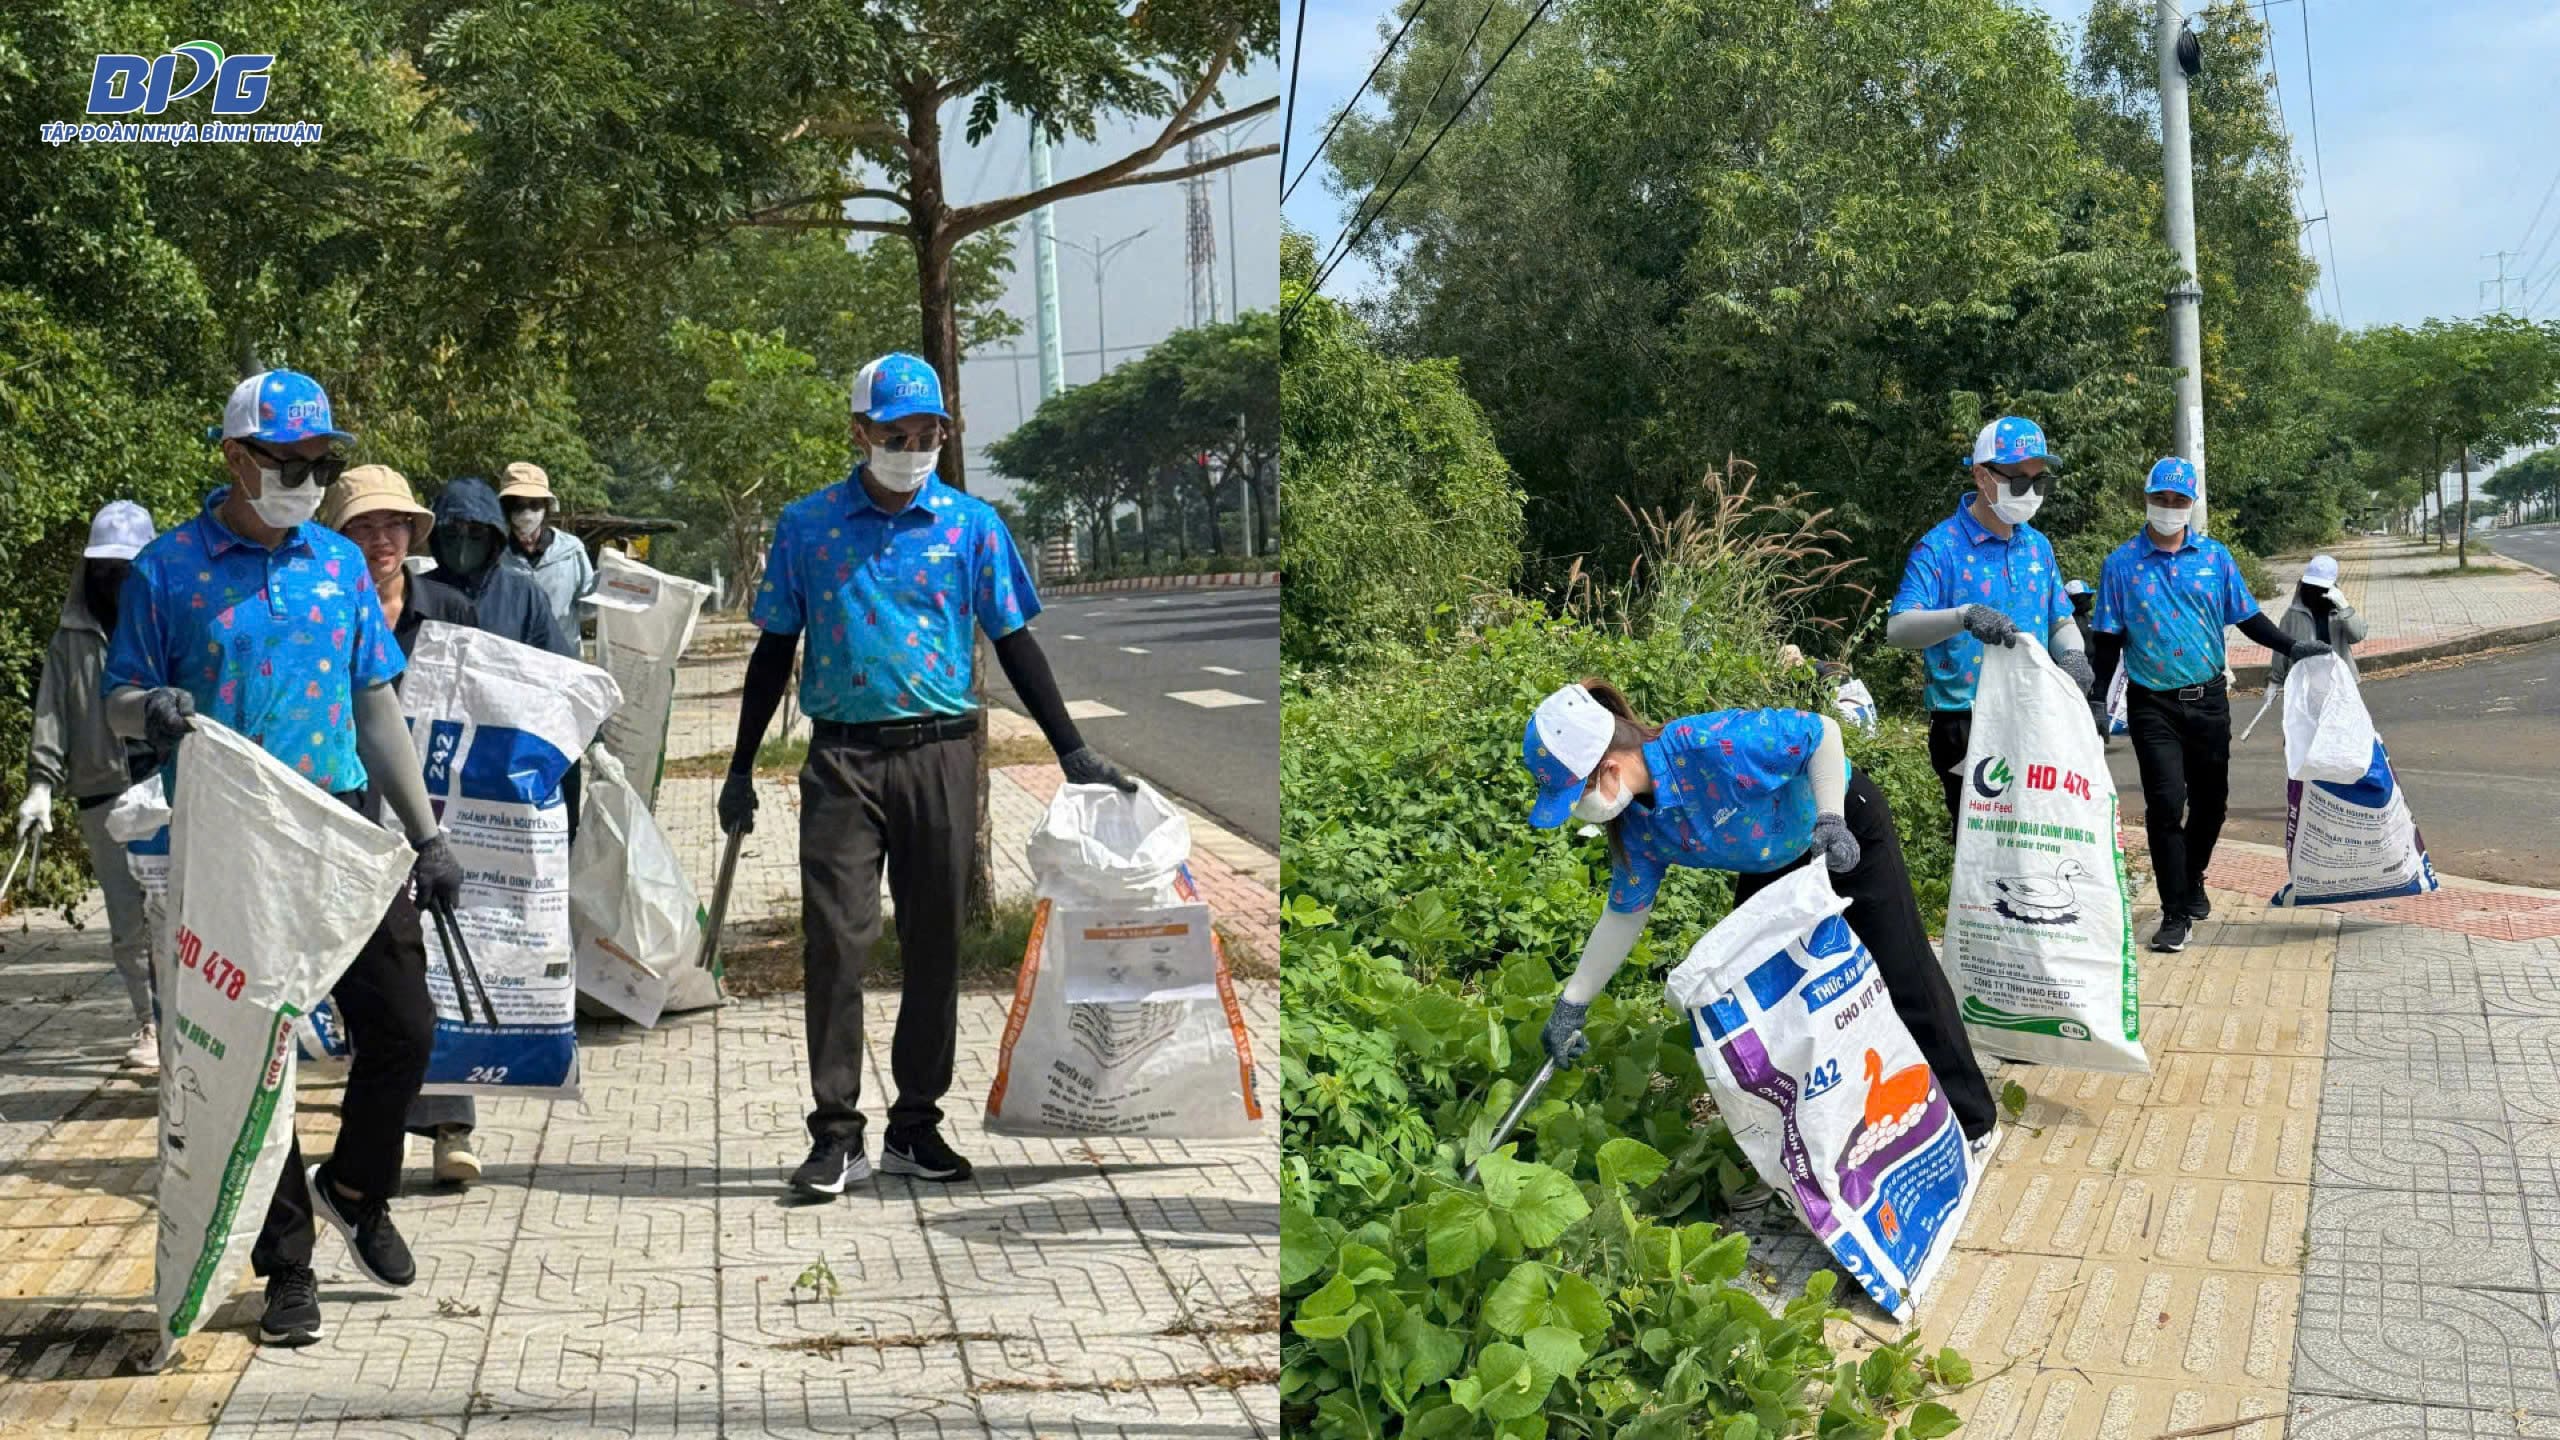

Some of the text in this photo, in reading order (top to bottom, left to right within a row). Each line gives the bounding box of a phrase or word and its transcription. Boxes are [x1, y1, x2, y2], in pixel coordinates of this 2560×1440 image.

[429, 733, 455, 781] 242
[2026, 764, 2092, 801] HD 478
[1968, 800, 2013, 813] Haid Feed
[203, 951, 246, 1000] 478
[1812, 975, 1845, 1002] THỨC
[2047, 989, 2070, 999] FEED
[1834, 1003, 1860, 1030] CHO
[1860, 986, 1873, 1009] VỊT
[464, 1066, 509, 1083] 242
[1804, 1057, 1842, 1096] 242
